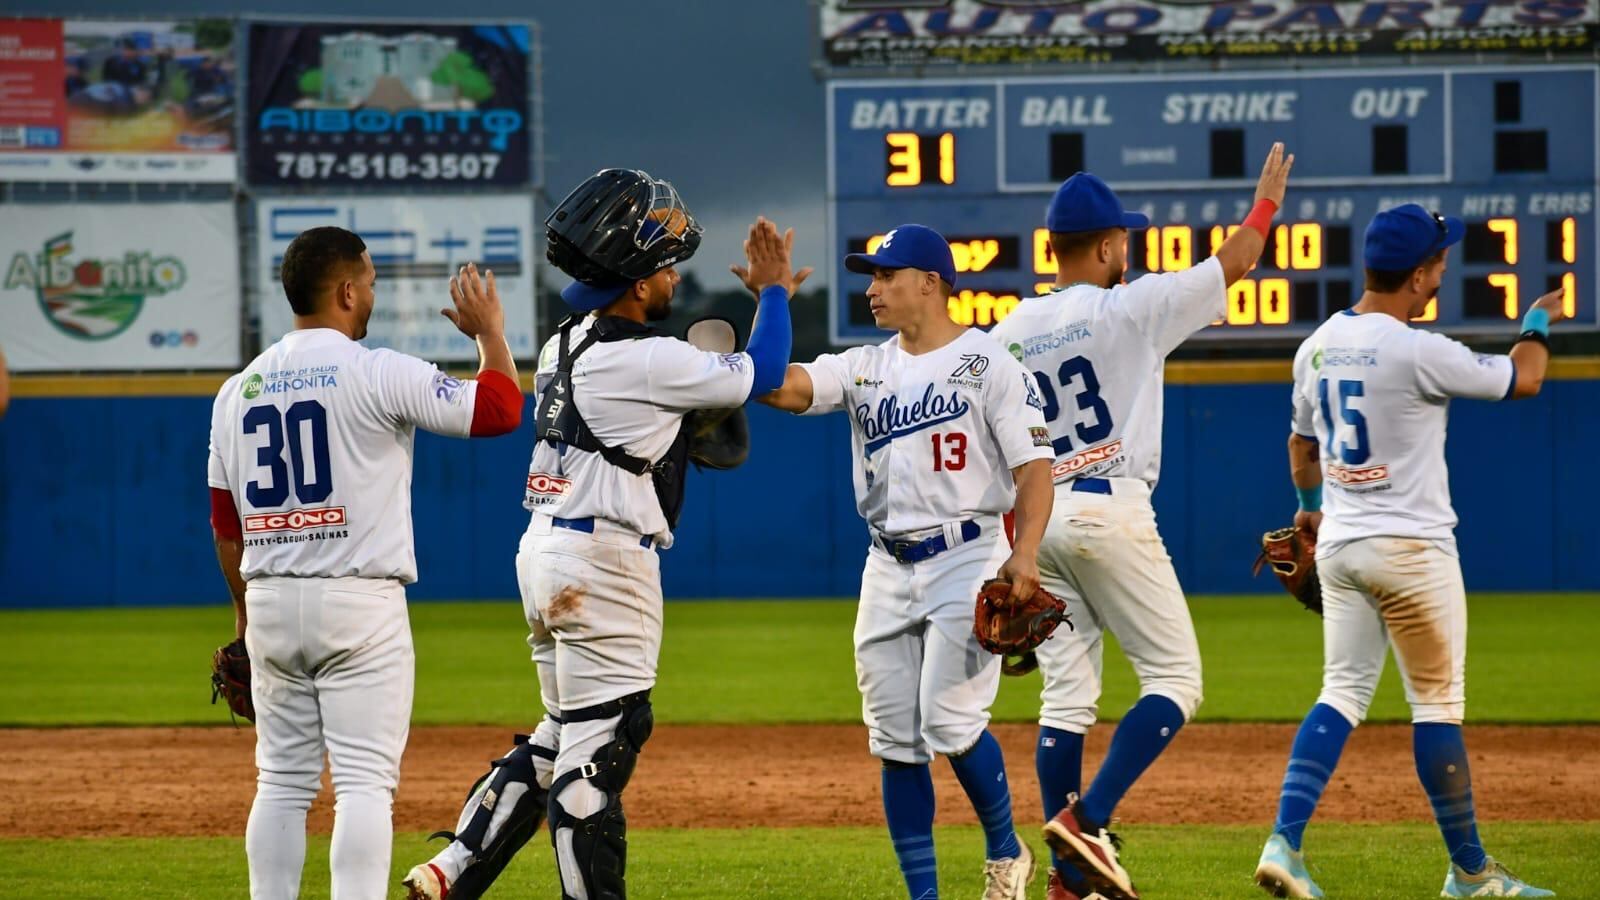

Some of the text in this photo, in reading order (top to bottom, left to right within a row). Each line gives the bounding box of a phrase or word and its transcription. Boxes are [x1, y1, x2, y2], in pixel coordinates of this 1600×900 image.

[832, 0, 1587, 36] AUTO PARTS
[851, 99, 991, 129] BATTER
[1020, 96, 1113, 126] BALL
[1162, 91, 1297, 123] STRIKE
[1351, 88, 1428, 119] OUT
[259, 107, 522, 150] AIBONITO
[276, 153, 500, 179] 787-518-3507
[885, 131, 956, 187] 31
[1461, 194, 1516, 216] HITS
[1528, 193, 1591, 215] ERRS
[4, 250, 187, 297] Aibonito
[1024, 327, 1092, 359] MENONITA
[311, 365, 338, 373] SALUD
[951, 353, 989, 377] 70
[1033, 355, 1114, 457] 23
[1319, 377, 1371, 465] 15
[243, 400, 333, 508] 30
[931, 432, 968, 472] 13
[1053, 443, 1121, 476] CONO
[246, 511, 341, 529] ECONO
